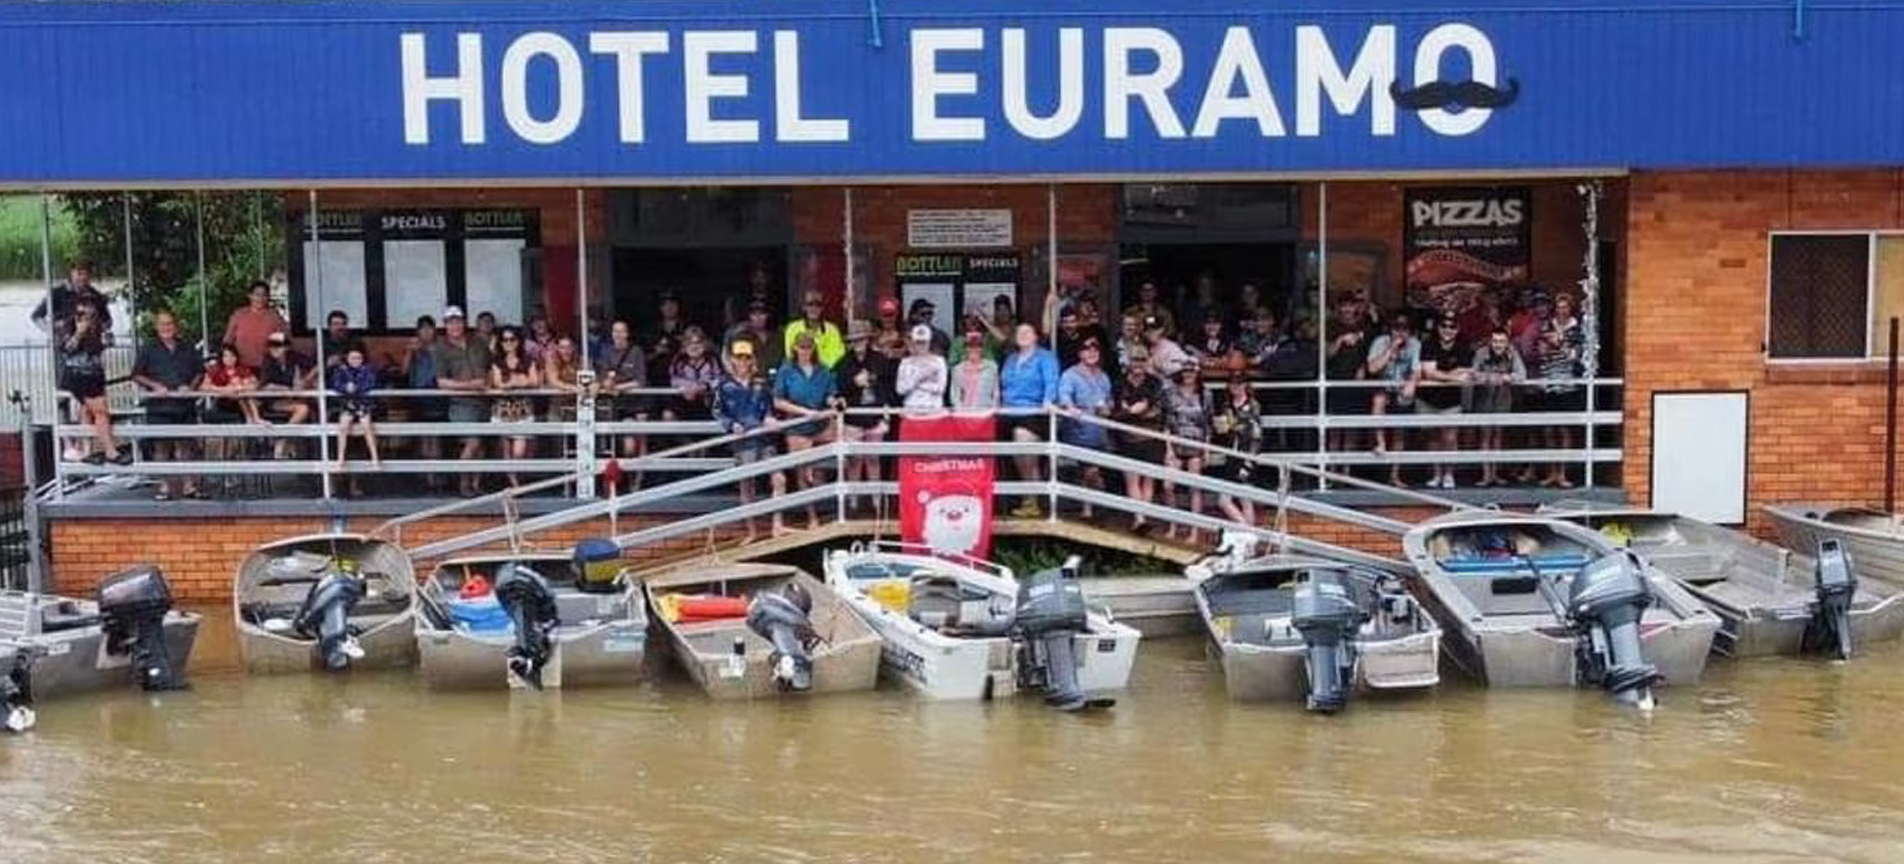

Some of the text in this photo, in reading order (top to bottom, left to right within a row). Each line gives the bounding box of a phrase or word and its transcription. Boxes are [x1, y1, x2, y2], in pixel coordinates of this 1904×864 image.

[402, 23, 1496, 144] HOTEL EURAMO
[1412, 199, 1522, 227] PIZZAS
[381, 215, 446, 229] SPECIALS
[969, 258, 1018, 268] SPECIALS
[914, 458, 984, 473] CHRISTMAS
